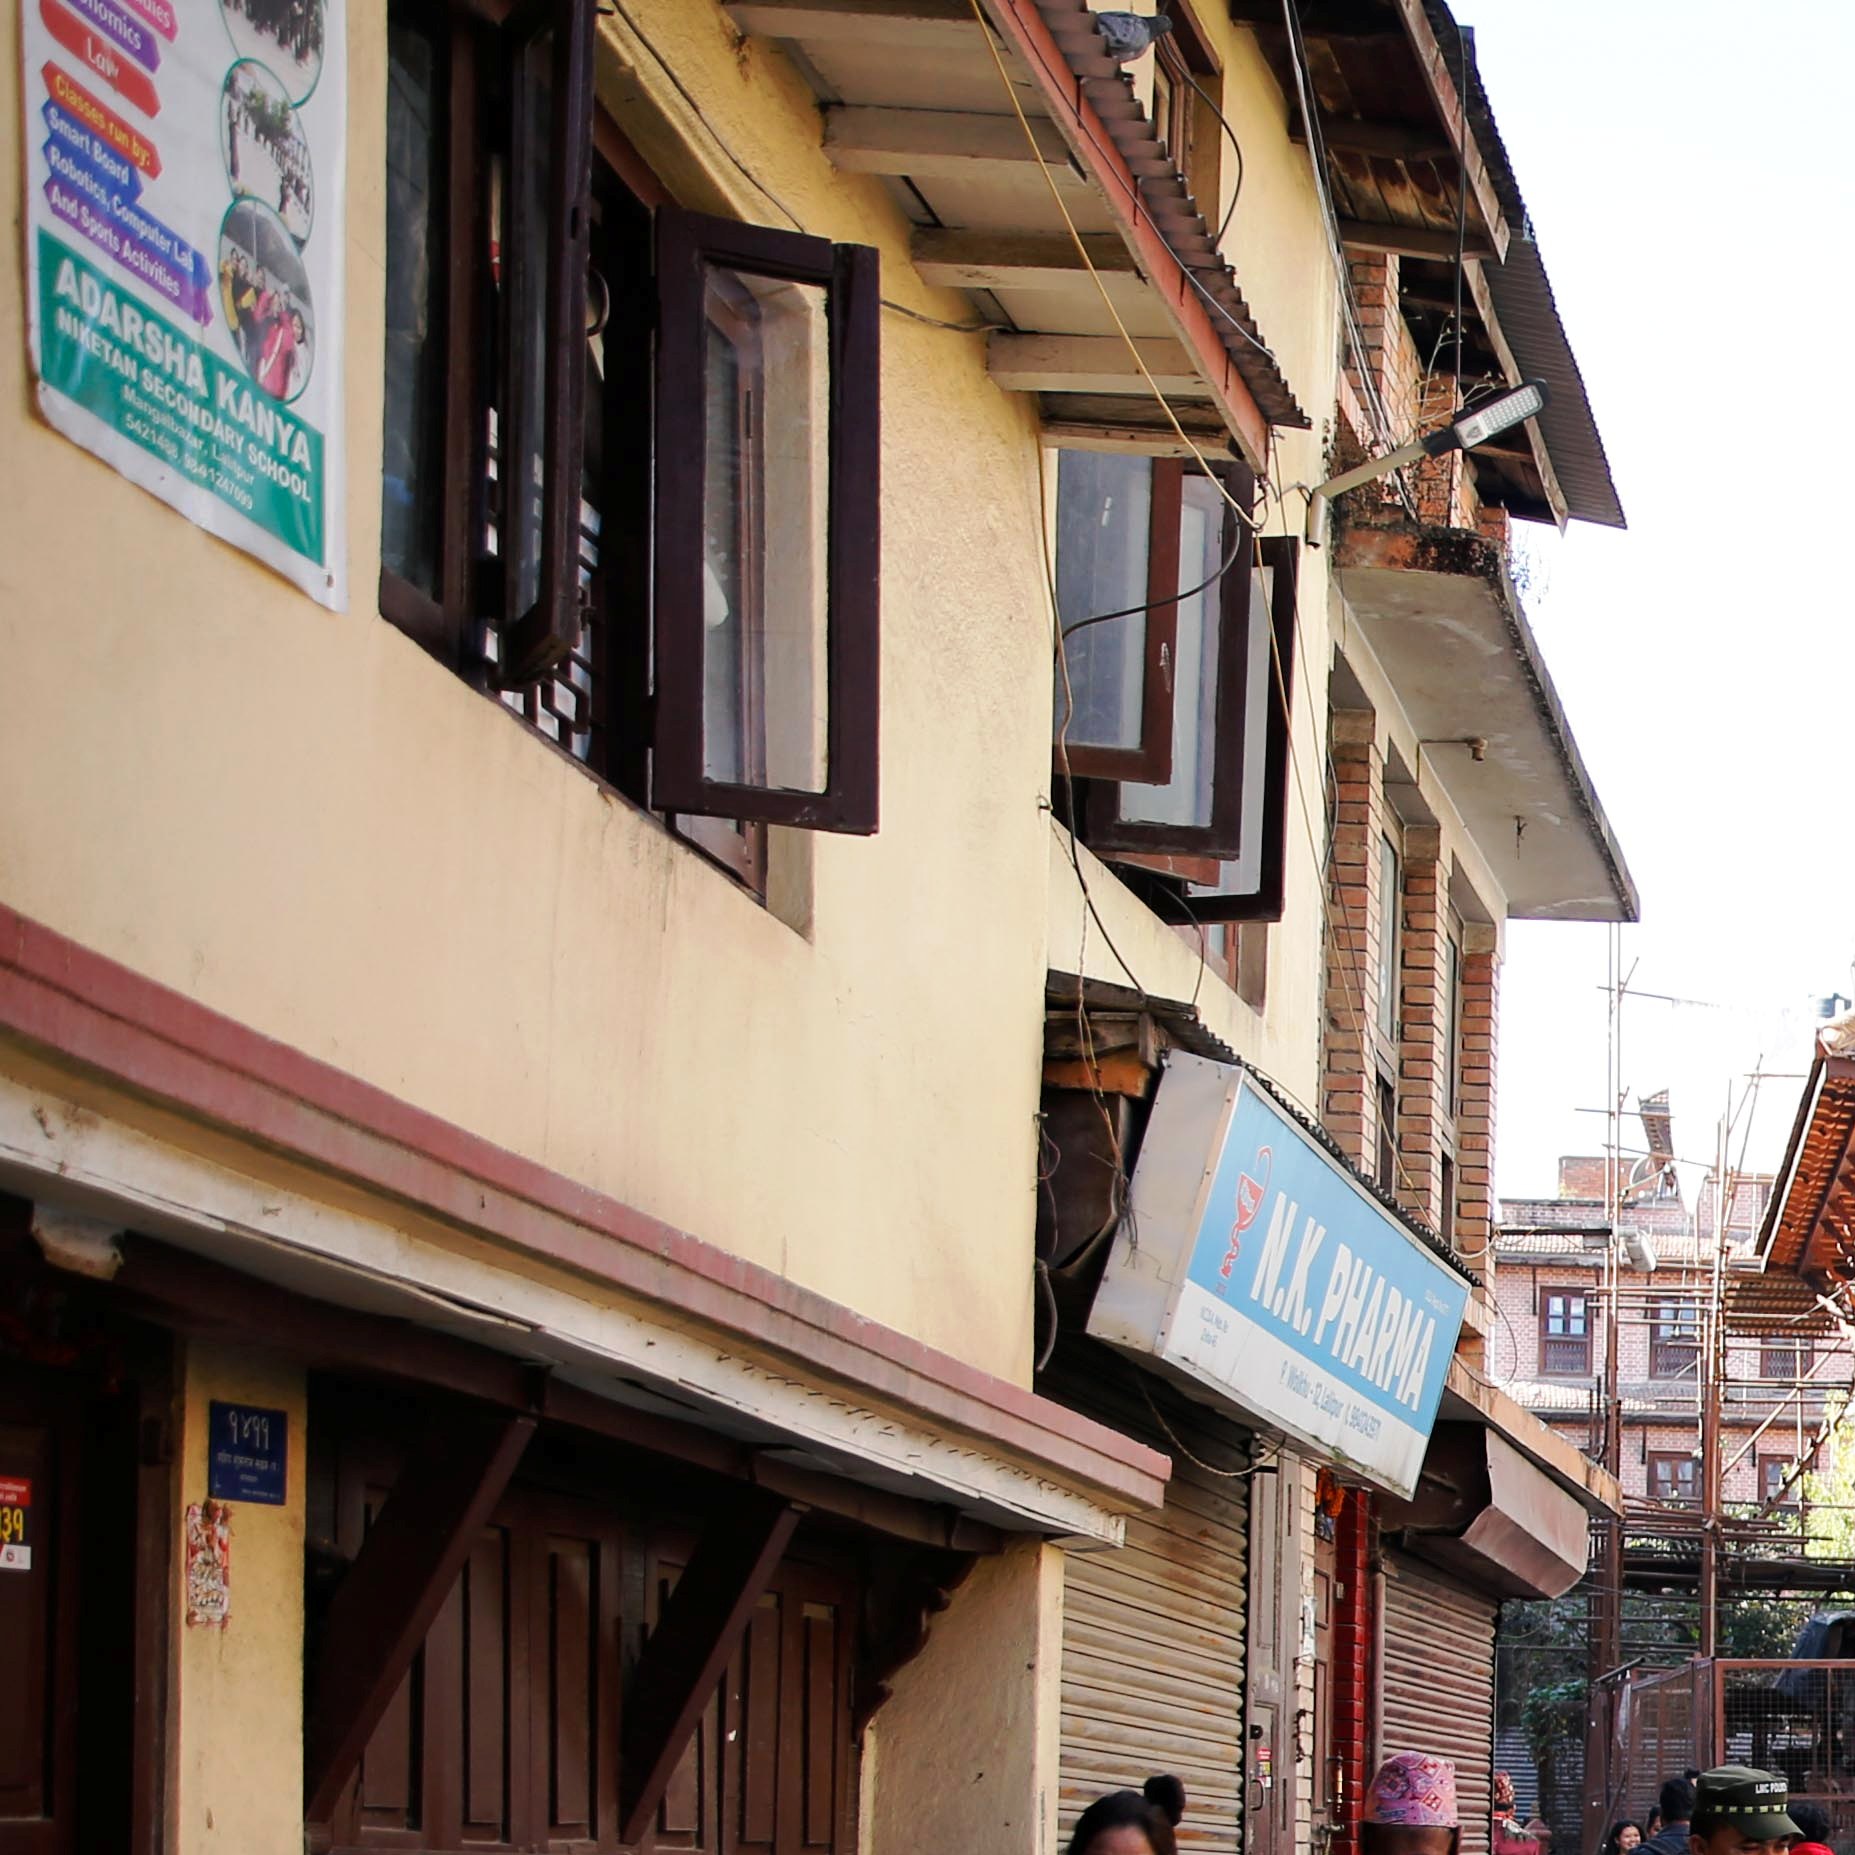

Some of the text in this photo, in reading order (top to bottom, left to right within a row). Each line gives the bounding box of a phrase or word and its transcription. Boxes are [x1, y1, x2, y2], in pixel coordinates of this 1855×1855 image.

[50, 107, 130, 186] Smart Board
[55, 75, 106, 129] Classes
[109, 121, 129, 148] run
[52, 185, 180, 297] And Sports Activities
[112, 195, 171, 254] Computer
[174, 241, 195, 273] Lab
[56, 258, 312, 472] ADARSHA KANYA
[57, 306, 312, 503] NIKETAN SECONDARY SCHOOL
[1250, 1191, 1437, 1413] N.K. PHARMA
